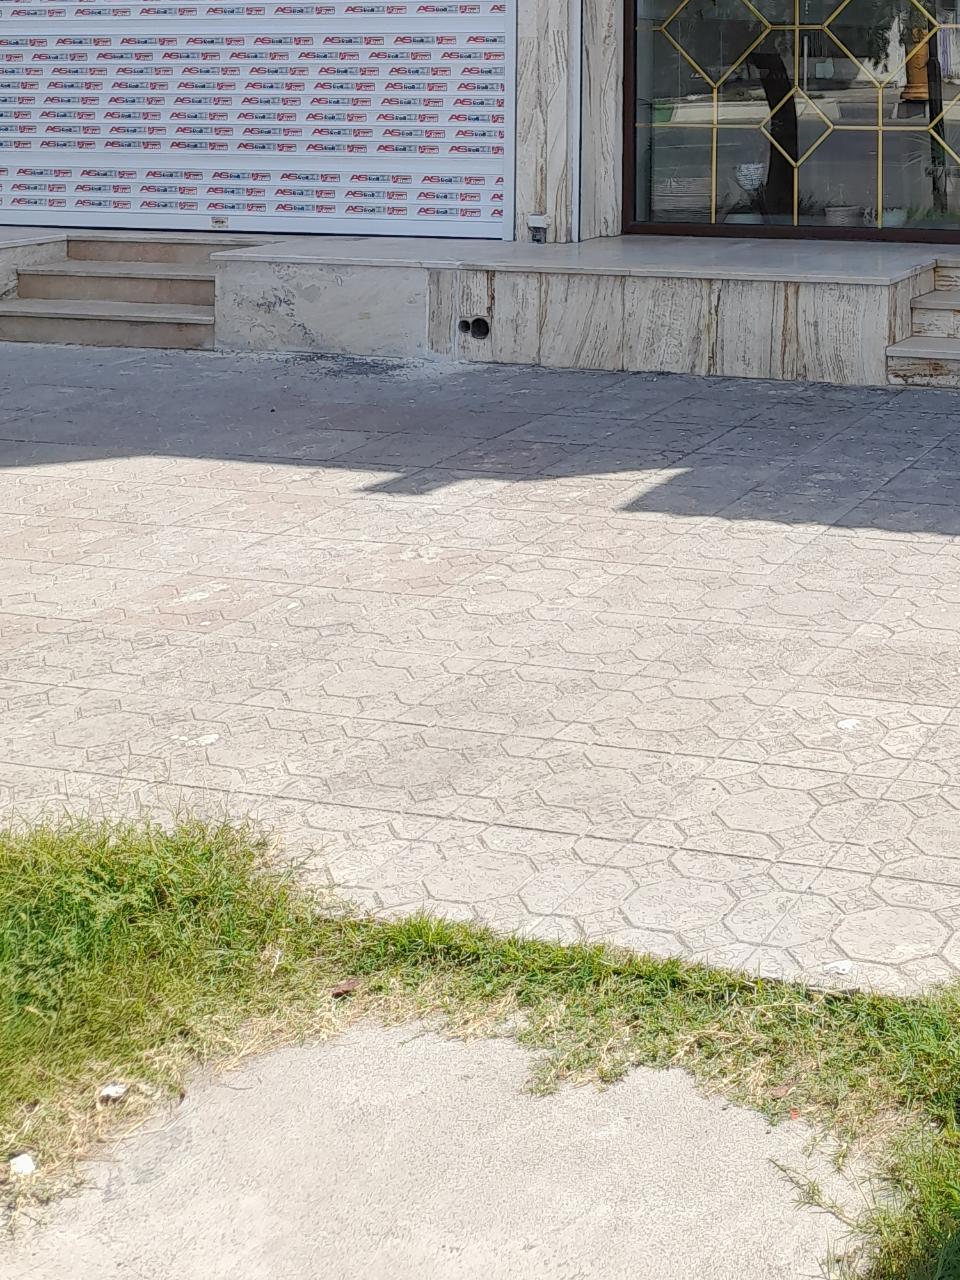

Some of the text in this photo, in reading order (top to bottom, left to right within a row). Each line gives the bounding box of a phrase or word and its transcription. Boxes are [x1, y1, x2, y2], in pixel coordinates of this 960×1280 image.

[176, 82, 194, 90] AS
[453, 98, 472, 106] AS
[169, 112, 186, 120] AS
[454, 130, 474, 138] AS
[39, 140, 56, 148] AS
